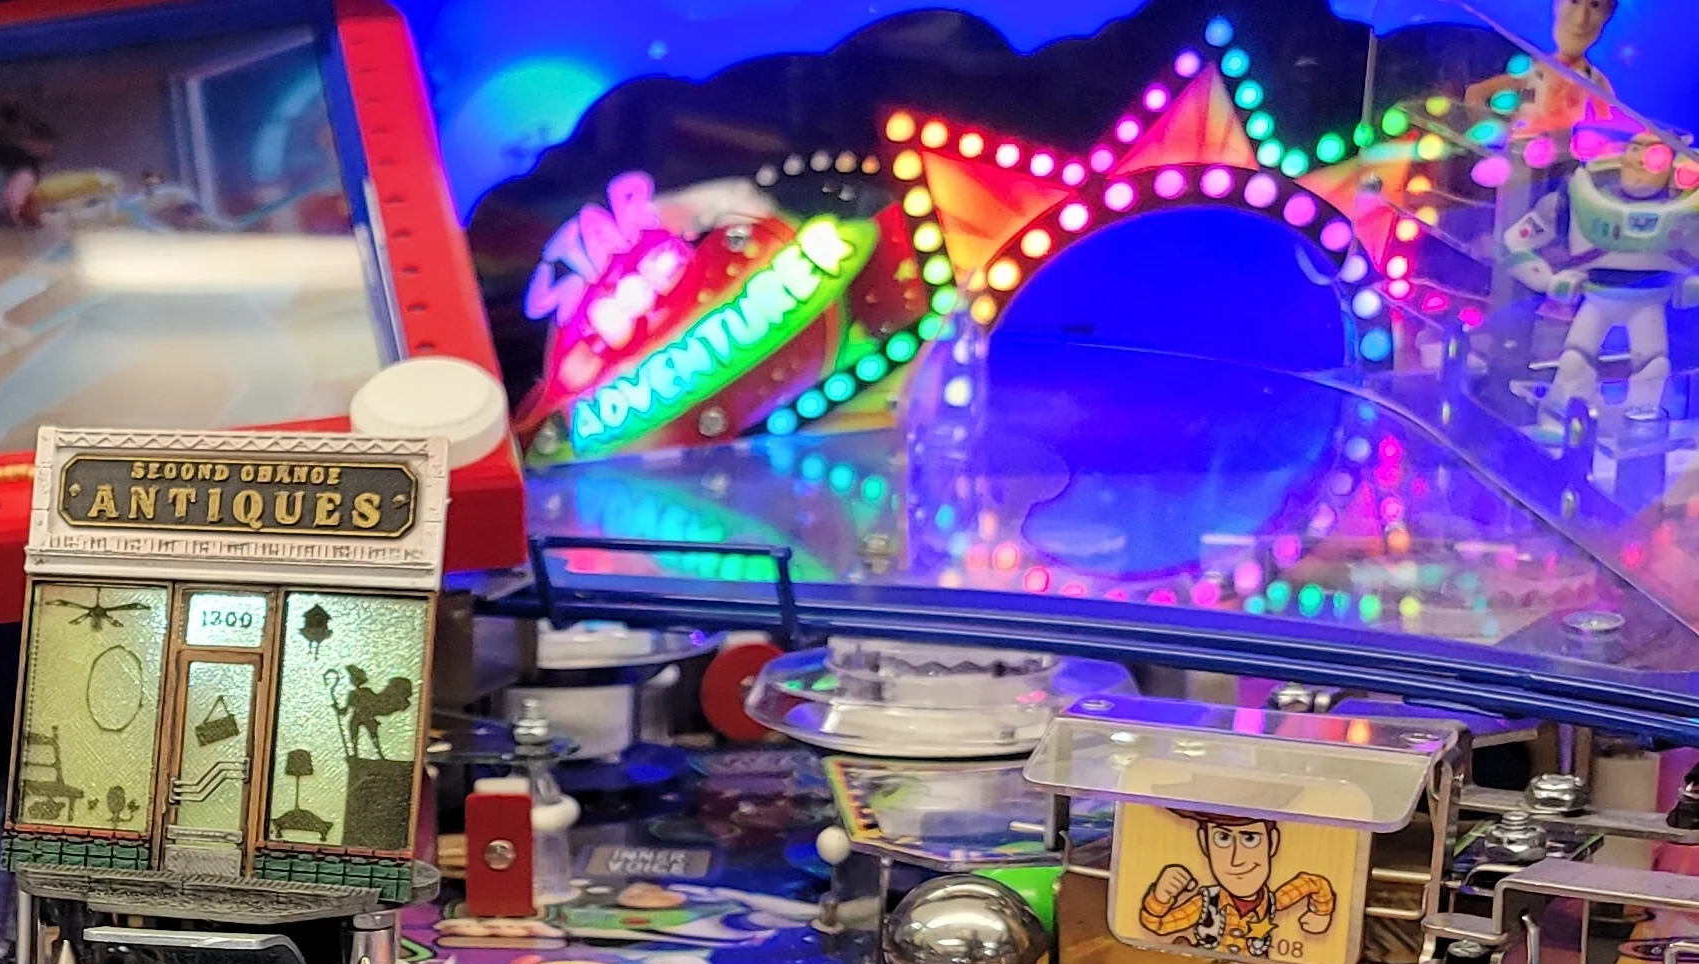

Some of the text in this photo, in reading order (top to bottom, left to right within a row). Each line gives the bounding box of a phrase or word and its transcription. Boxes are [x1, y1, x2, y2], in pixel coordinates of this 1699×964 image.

[522, 170, 660, 326] STAR
[572, 216, 854, 442] ADVENTURER
[86, 484, 383, 531] ANTIQUES
[612, 848, 686, 862] INNER
